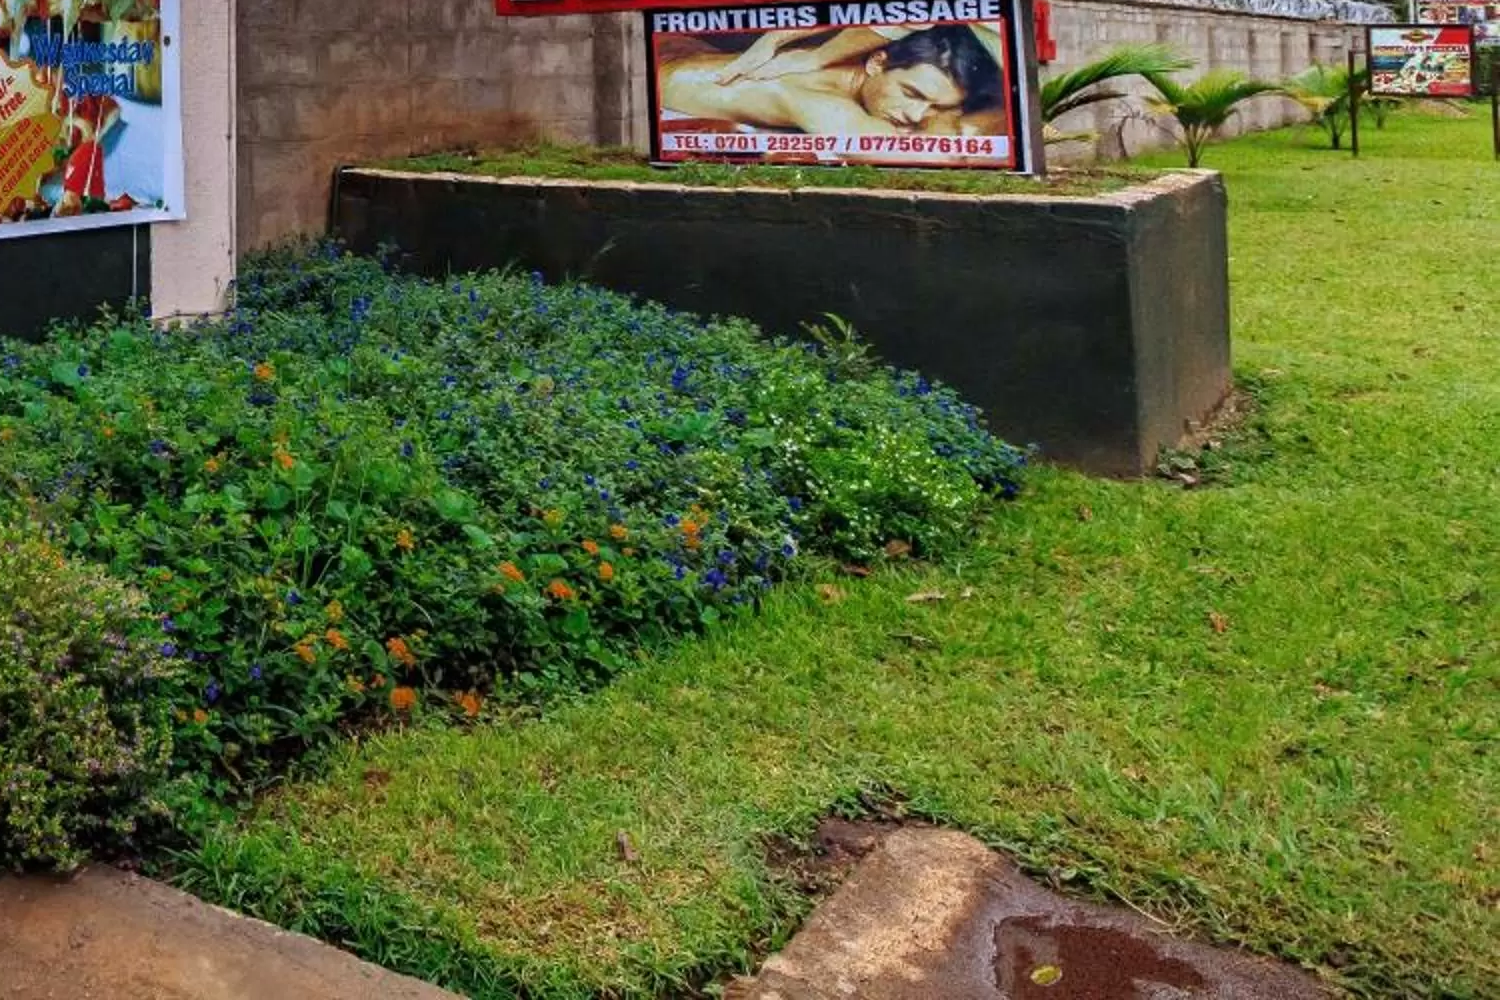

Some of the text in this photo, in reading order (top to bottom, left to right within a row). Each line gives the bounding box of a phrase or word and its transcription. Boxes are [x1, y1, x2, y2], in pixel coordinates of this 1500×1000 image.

[653, 6, 818, 32] FRONTIERS
[674, 135, 709, 150] TEL:
[714, 135, 757, 150] 0701
[767, 136, 838, 151] 292567
